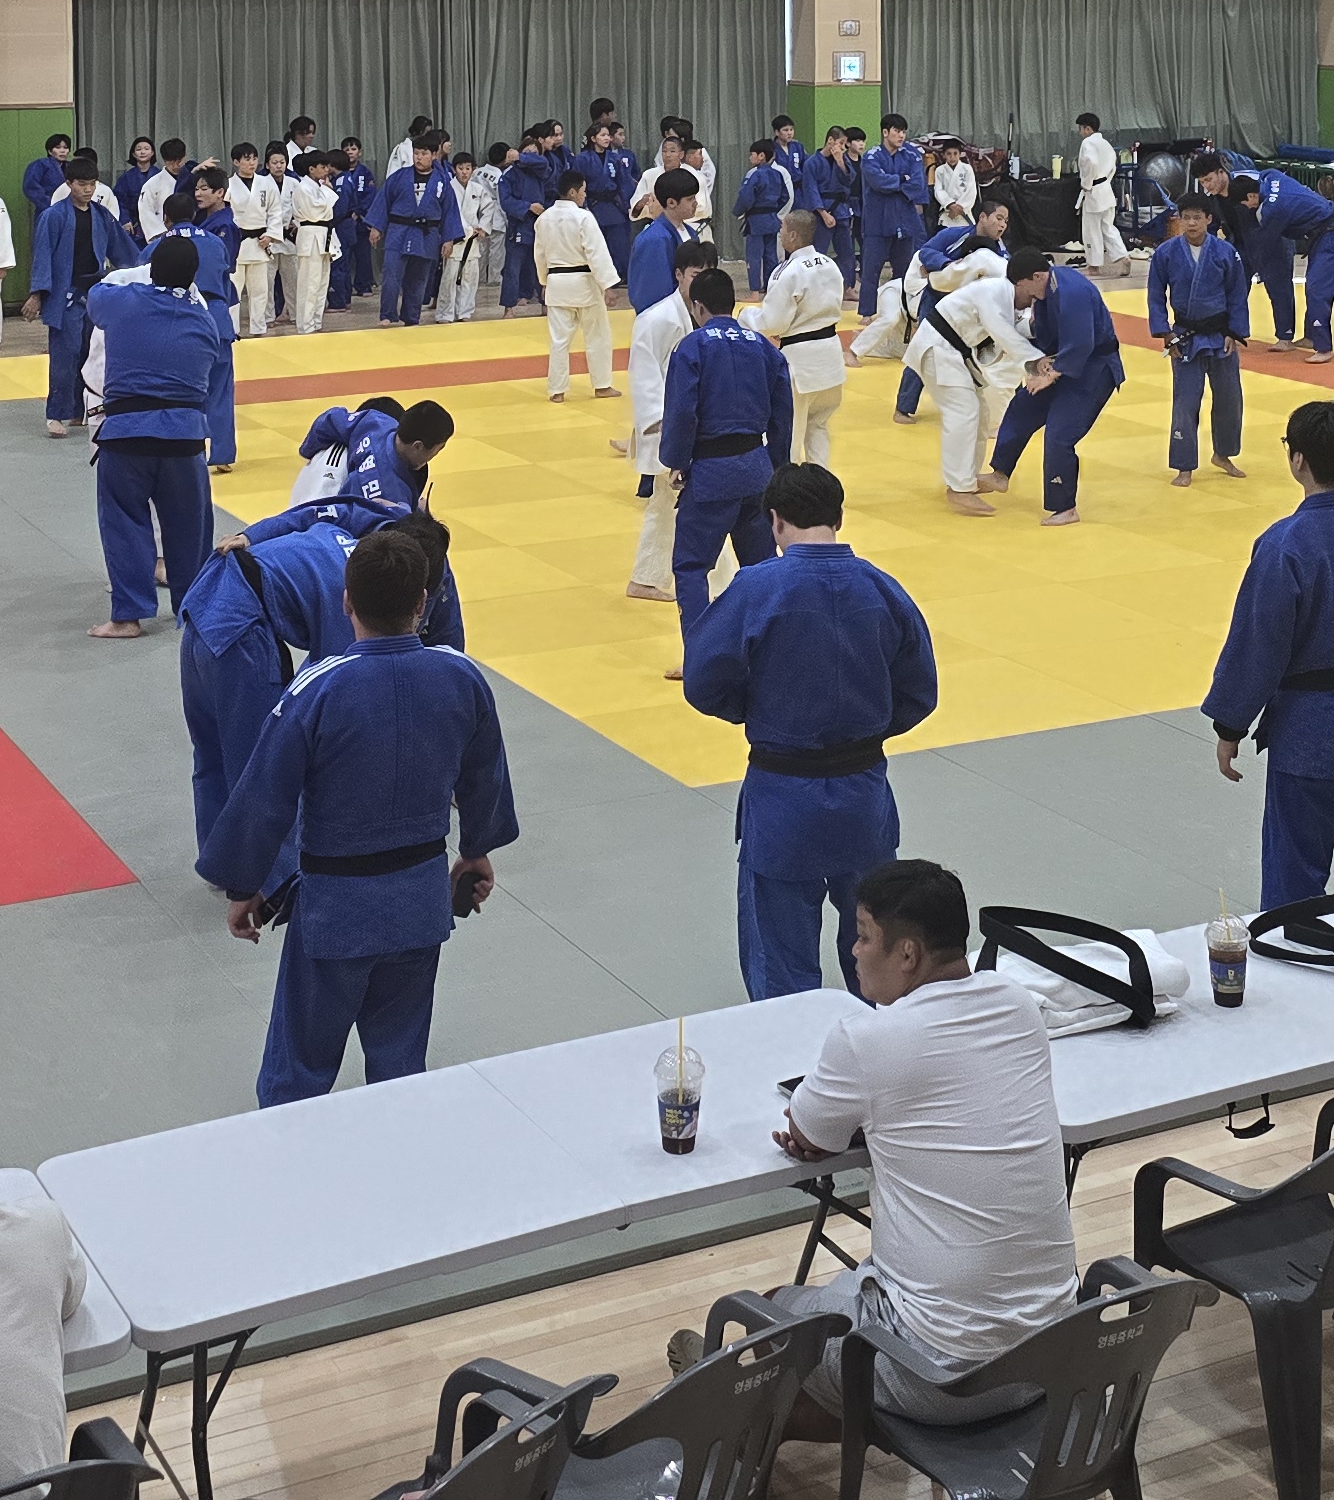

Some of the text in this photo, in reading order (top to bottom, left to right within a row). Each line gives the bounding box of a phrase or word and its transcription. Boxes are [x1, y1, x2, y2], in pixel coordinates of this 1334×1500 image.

[1097, 1323, 1144, 1349] 영동중학교
[734, 1364, 780, 1395] 영동중학교
[514, 1433, 557, 1473] 영동중학교
